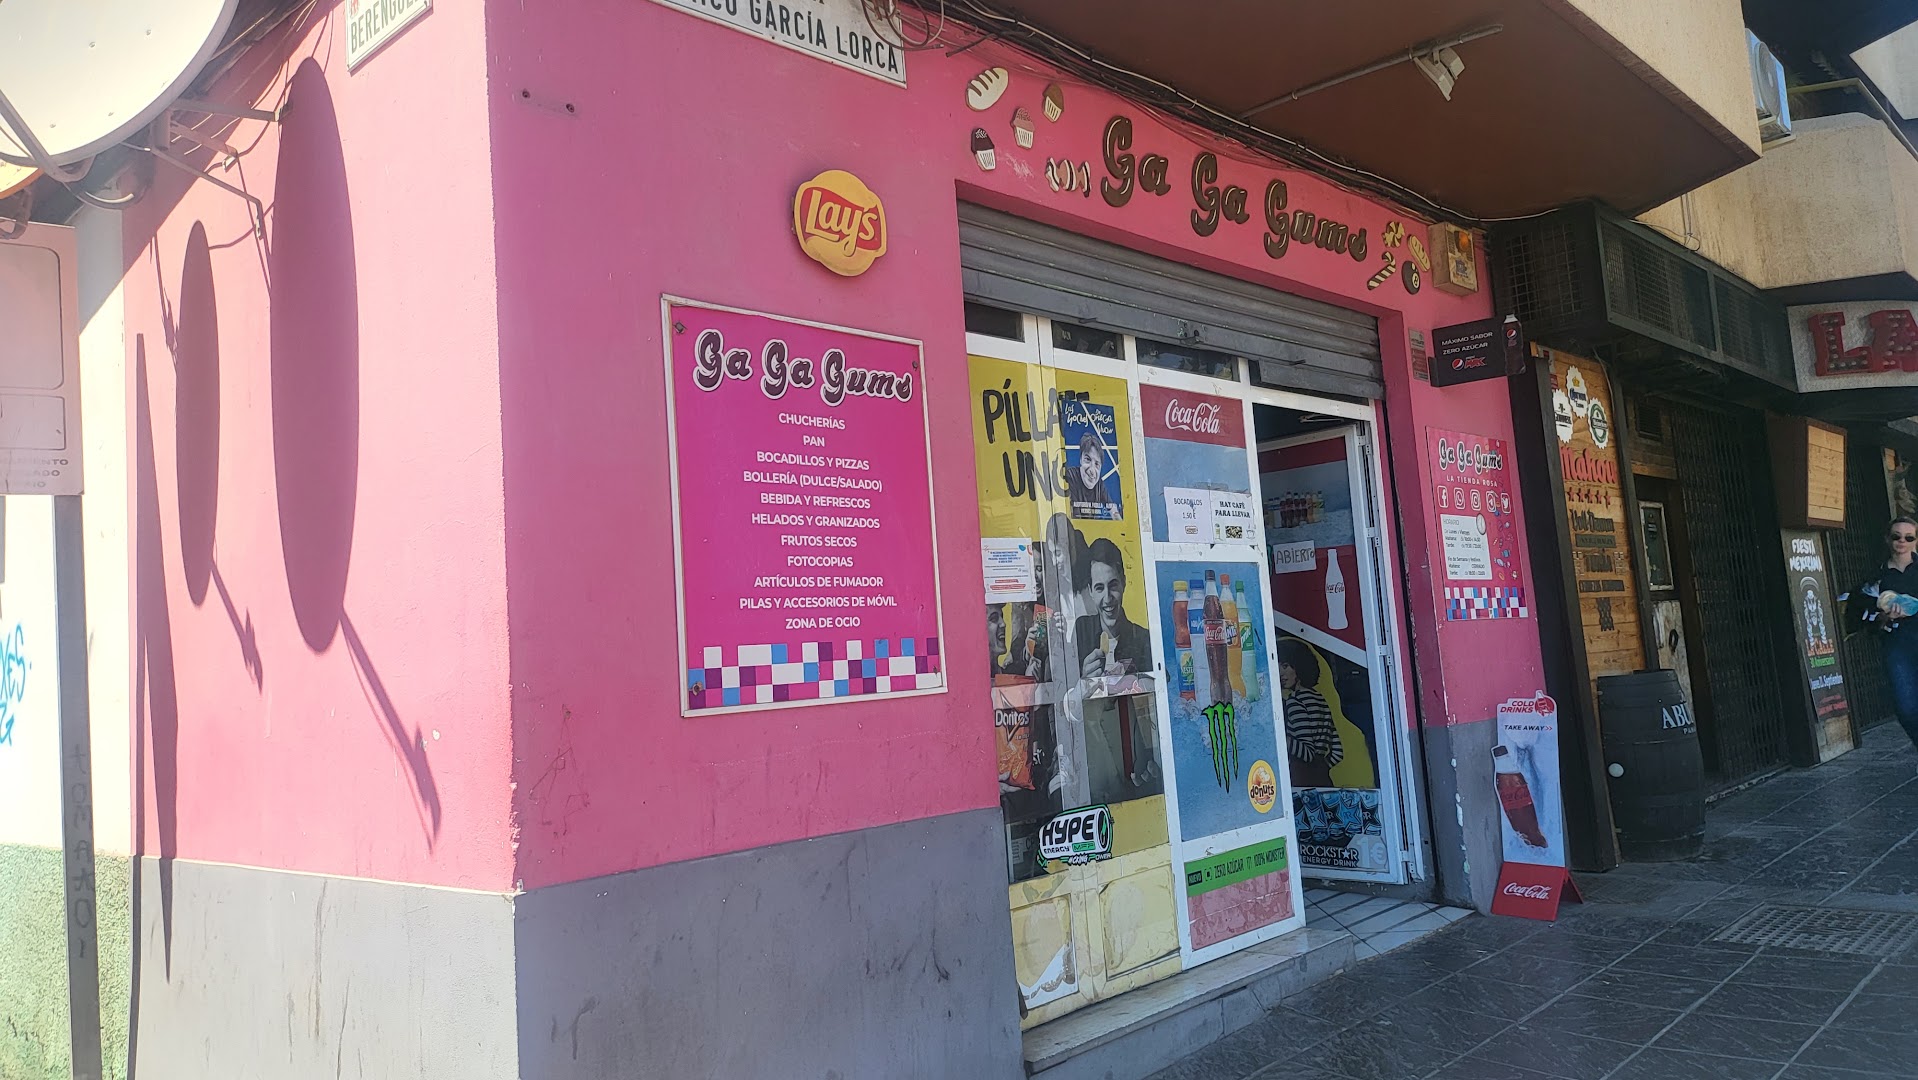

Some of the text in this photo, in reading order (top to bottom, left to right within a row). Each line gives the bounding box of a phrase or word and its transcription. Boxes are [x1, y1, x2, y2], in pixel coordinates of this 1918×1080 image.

[351, 0, 419, 54] BERENGU
[750, 0, 899, 74] GARCÍA LORCA
[1100, 115, 1368, 262] Ga Ga Gums
[805, 189, 878, 257] Lay's
[1441, 331, 1493, 346] MÁXIMO SABOR
[1442, 342, 1488, 355] ZERO AZÚCAR
[693, 328, 913, 407] Ga Ga Gums
[778, 412, 846, 430] CHUCHERÍAS
[1165, 398, 1222, 434] Coca-Cola
[803, 435, 825, 447] PAN
[756, 451, 870, 470] BOCADILLOS Y PIZZAS
[1439, 437, 1503, 475] Ga Ga Gums
[743, 470, 883, 493] BOLLERÍA (DULCE/SALADO)
[1446, 475, 1498, 487] LA TIENDA ROSA
[760, 493, 871, 509] BEBIDA Y REFRESCOS
[751, 513, 880, 529] HELADOS Y GRANIZADOS
[1231, 510, 1251, 518] LLEVAR
[781, 535, 857, 547] FRUTOS SECOS
[1791, 538, 1816, 555] FIESTA
[787, 556, 854, 567] FOTOCOPIAS
[754, 575, 884, 588] ARTÍCULOS DE FUMADOR
[739, 595, 898, 609] PILAS Y ACCESORIOS DE MÓVIL
[785, 616, 861, 629] ZONA DE OCIO
[1500, 706, 1534, 714] DRINKS
[995, 709, 1030, 728] Doritos
[1250, 784, 1275, 799] donuts
[1042, 814, 1096, 847] HYPE
[1043, 846, 1070, 855] ENERGY
[1214, 863, 1227, 879] ZERO
[1227, 858, 1245, 875] AZÚCAR
[1266, 846, 1285, 863] MONSTER
[1303, 855, 1357, 868] ENERGY DRINK
[1503, 882, 1552, 900] Coca-Cola
